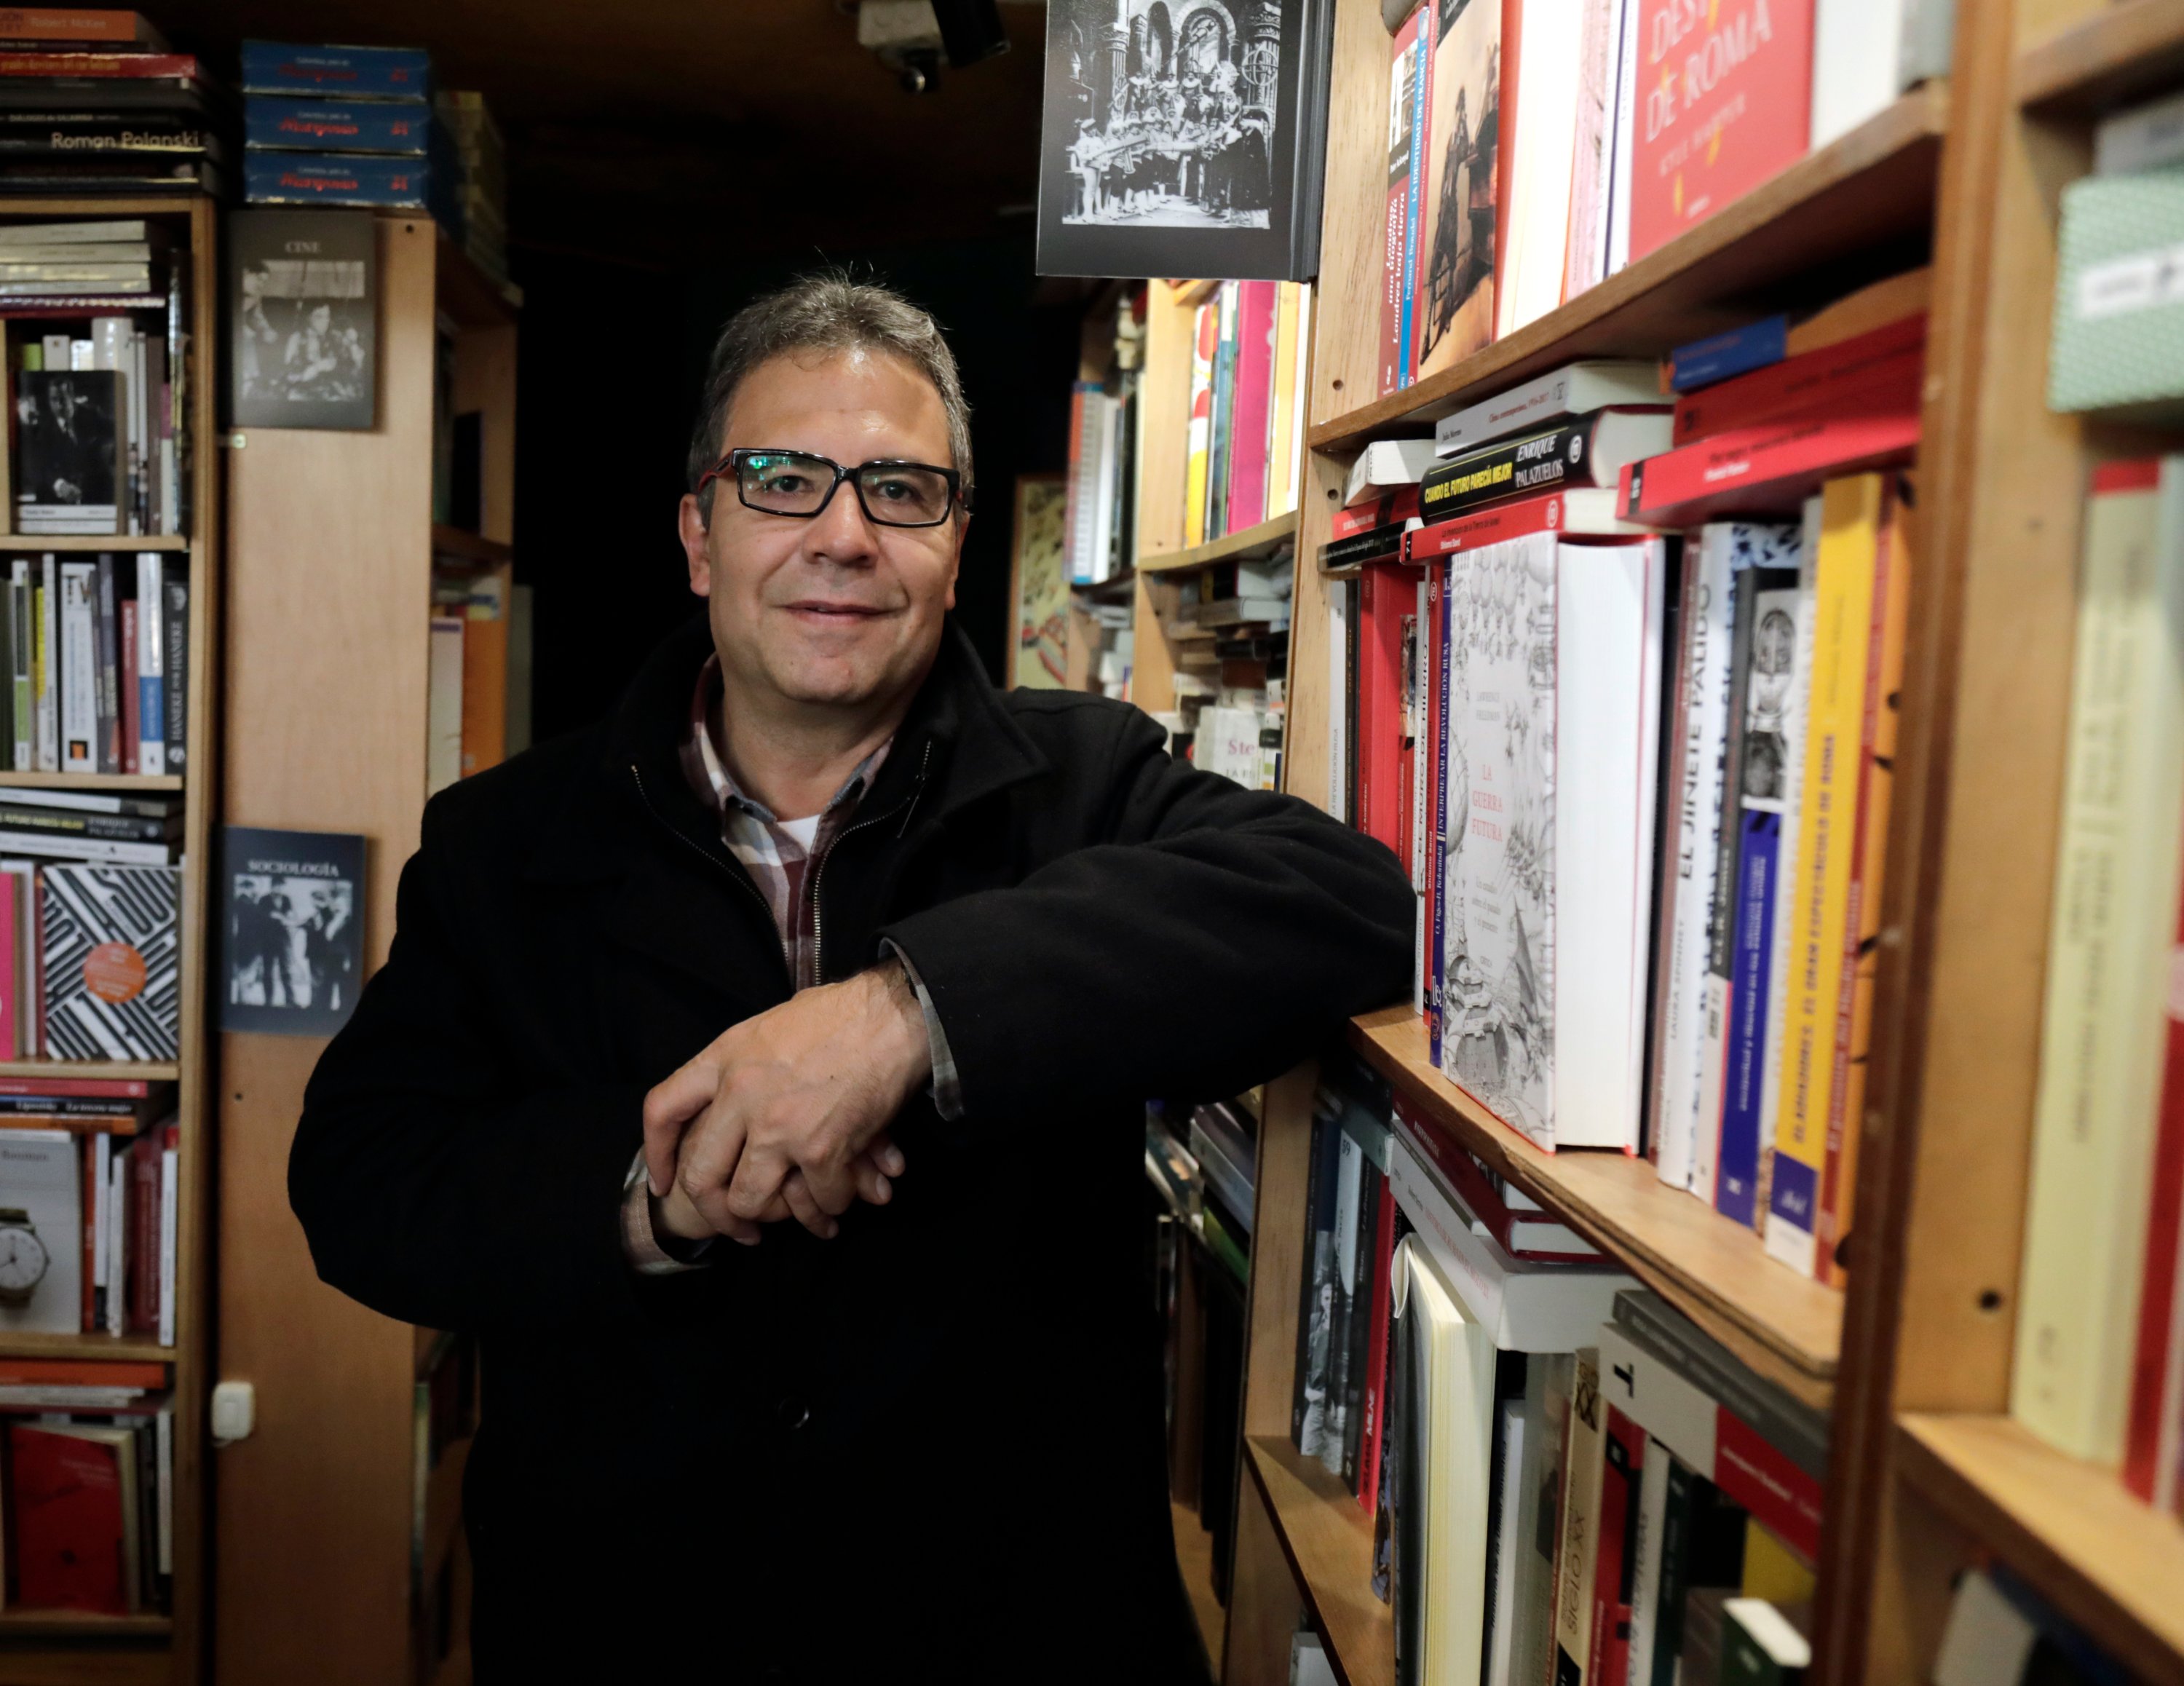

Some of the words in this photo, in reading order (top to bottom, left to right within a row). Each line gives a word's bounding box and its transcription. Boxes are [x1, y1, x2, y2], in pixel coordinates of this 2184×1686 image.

[1418, 50, 1427, 100] FRANCIA
[1417, 101, 1423, 119] DE
[1646, 73, 1678, 143] DE
[51, 132, 116, 149] Roman
[121, 131, 199, 148] Polanski
[1413, 122, 1422, 186] IDENTIDAD
[1412, 187, 1417, 202] LA
[285, 241, 321, 253] CINE
[1393, 280, 1401, 344] Londres
[1398, 192, 1406, 236] tierra
[1516, 435, 1558, 463] ENRIQUE
[1425, 482, 1444, 504] CUANDO
[1450, 474, 1470, 496] FUTURO
[1471, 464, 1492, 494] PARECÍA
[1492, 462, 1513, 486] MEJOR
[1514, 459, 1564, 488] PALAZUELOS
[1420, 729, 1426, 756] DE
[1440, 745, 1446, 759] LA
[1481, 764, 1492, 781] LA
[1682, 724, 1701, 836] JINETE
[1437, 762, 1446, 830] INTERPRETAR
[1473, 790, 1503, 813] GUERRA
[1419, 833, 1423, 853] EL
[1471, 818, 1503, 843] FUTURA
[248, 860, 339, 878] SOCIOLOGÍA
[1679, 847, 1694, 880] EL
[1670, 1000, 1681, 1040] LAURA
[1366, 1388, 1376, 1436] MILNE
[1567, 1556, 1582, 1635] SIGLO
